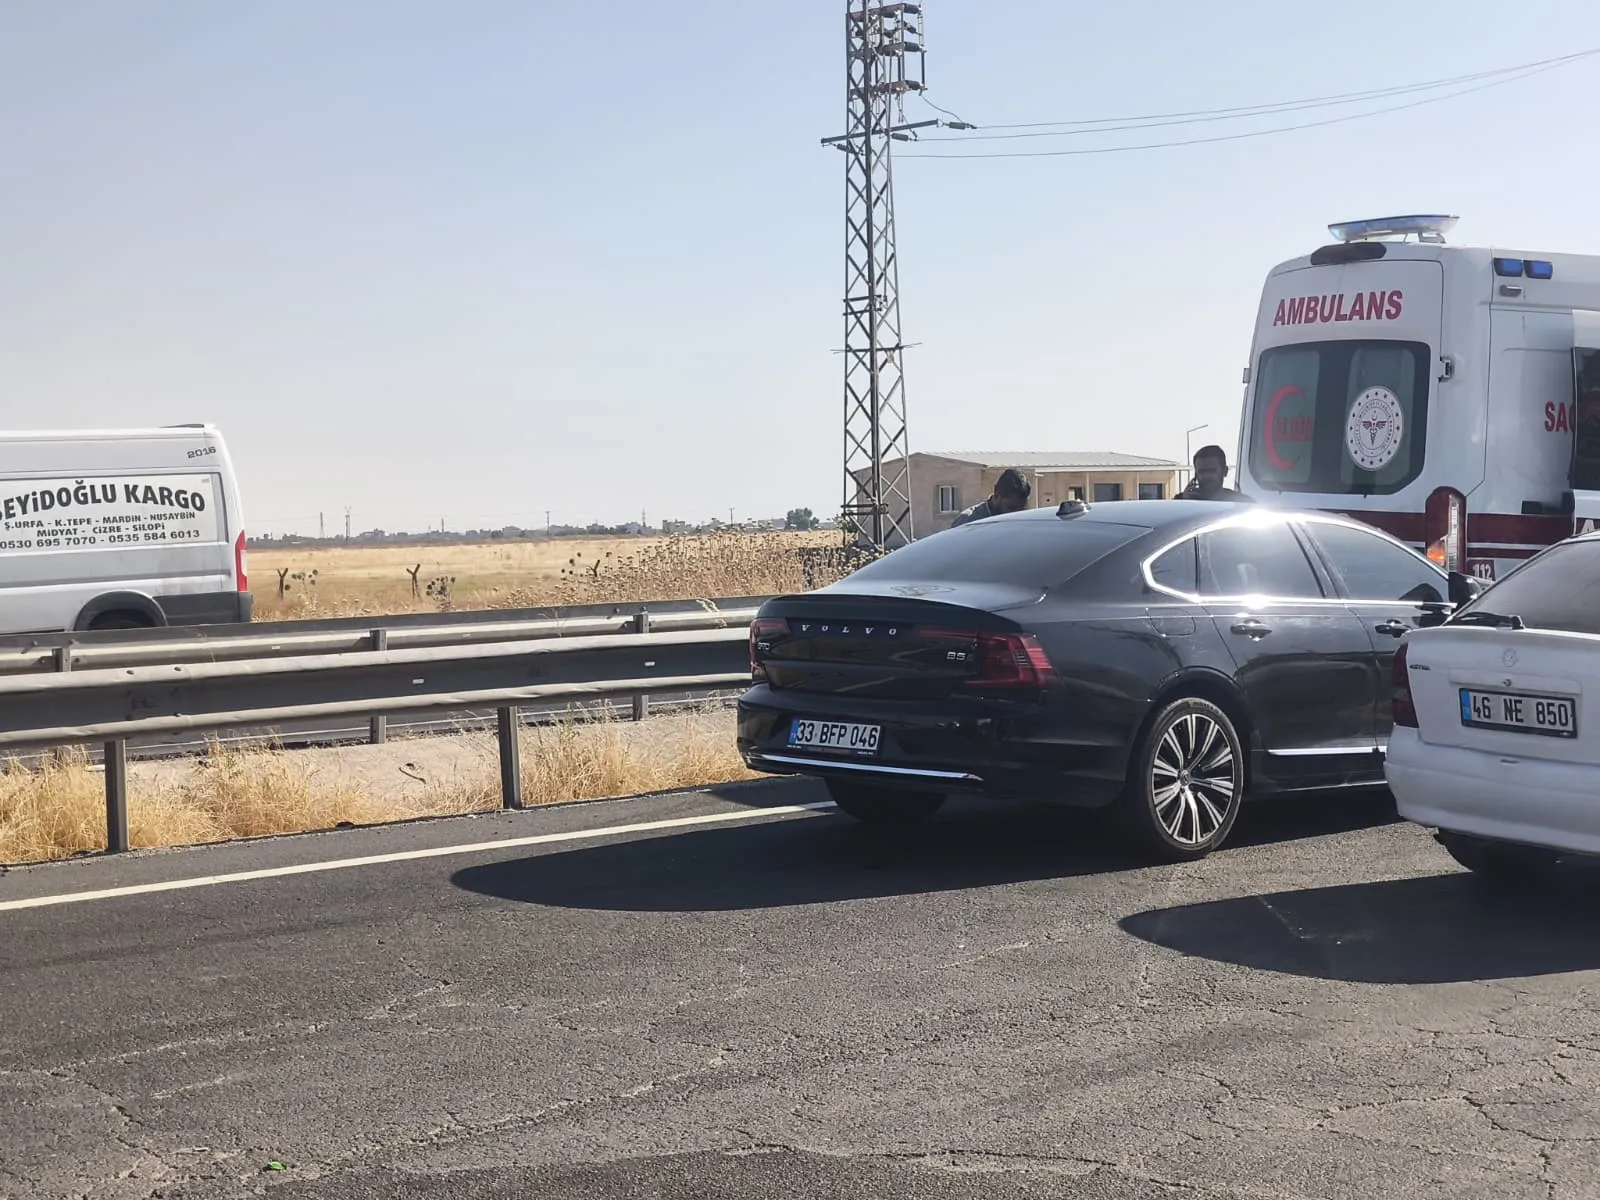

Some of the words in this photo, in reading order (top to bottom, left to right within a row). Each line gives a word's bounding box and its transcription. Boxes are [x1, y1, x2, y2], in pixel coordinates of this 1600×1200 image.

[1273, 290, 1403, 326] AMBULANS
[186, 446, 217, 459] 2016
[0, 480, 117, 520] EYiDOĞLU
[123, 484, 205, 511] KARGO
[4, 520, 44, 531] Ş.URFA
[54, 517, 92, 527] K.TEPE
[0, 540, 32, 550] 0530
[36, 537, 61, 548] 695
[64, 535, 97, 546] 7070
[108, 533, 140, 544] 0535
[143, 531, 167, 541] 584
[170, 529, 200, 540] 6013
[802, 624, 897, 635] VOLVO
[1473, 696, 1491, 719] 46
[1503, 698, 1525, 724] NE
[1536, 702, 1568, 727] 850
[796, 722, 815, 742] 33
[818, 723, 848, 745] BFP
[849, 725, 879, 748] 046
